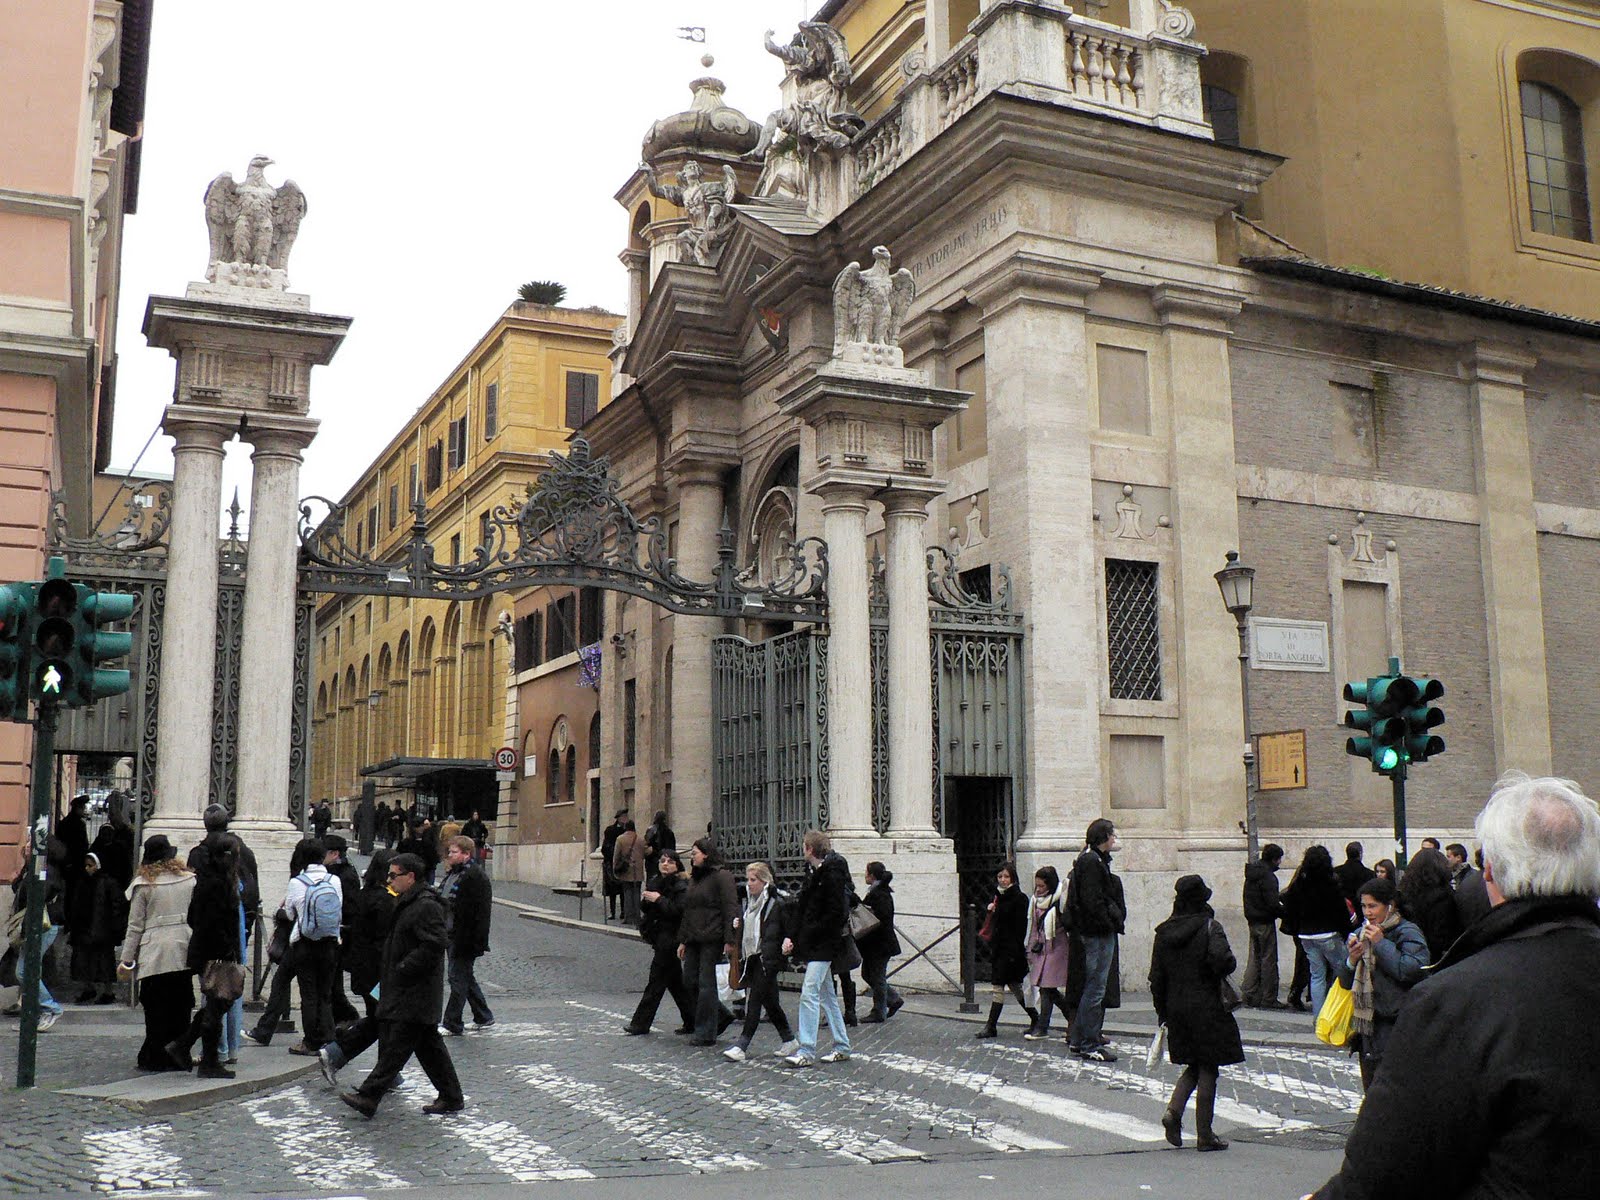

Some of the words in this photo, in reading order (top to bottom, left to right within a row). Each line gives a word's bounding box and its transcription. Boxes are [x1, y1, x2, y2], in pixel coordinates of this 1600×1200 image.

[1281, 631, 1298, 640] VIA
[1257, 650, 1282, 660] PORTA
[1286, 652, 1323, 662] ANGELICA
[500, 753, 513, 764] 30
